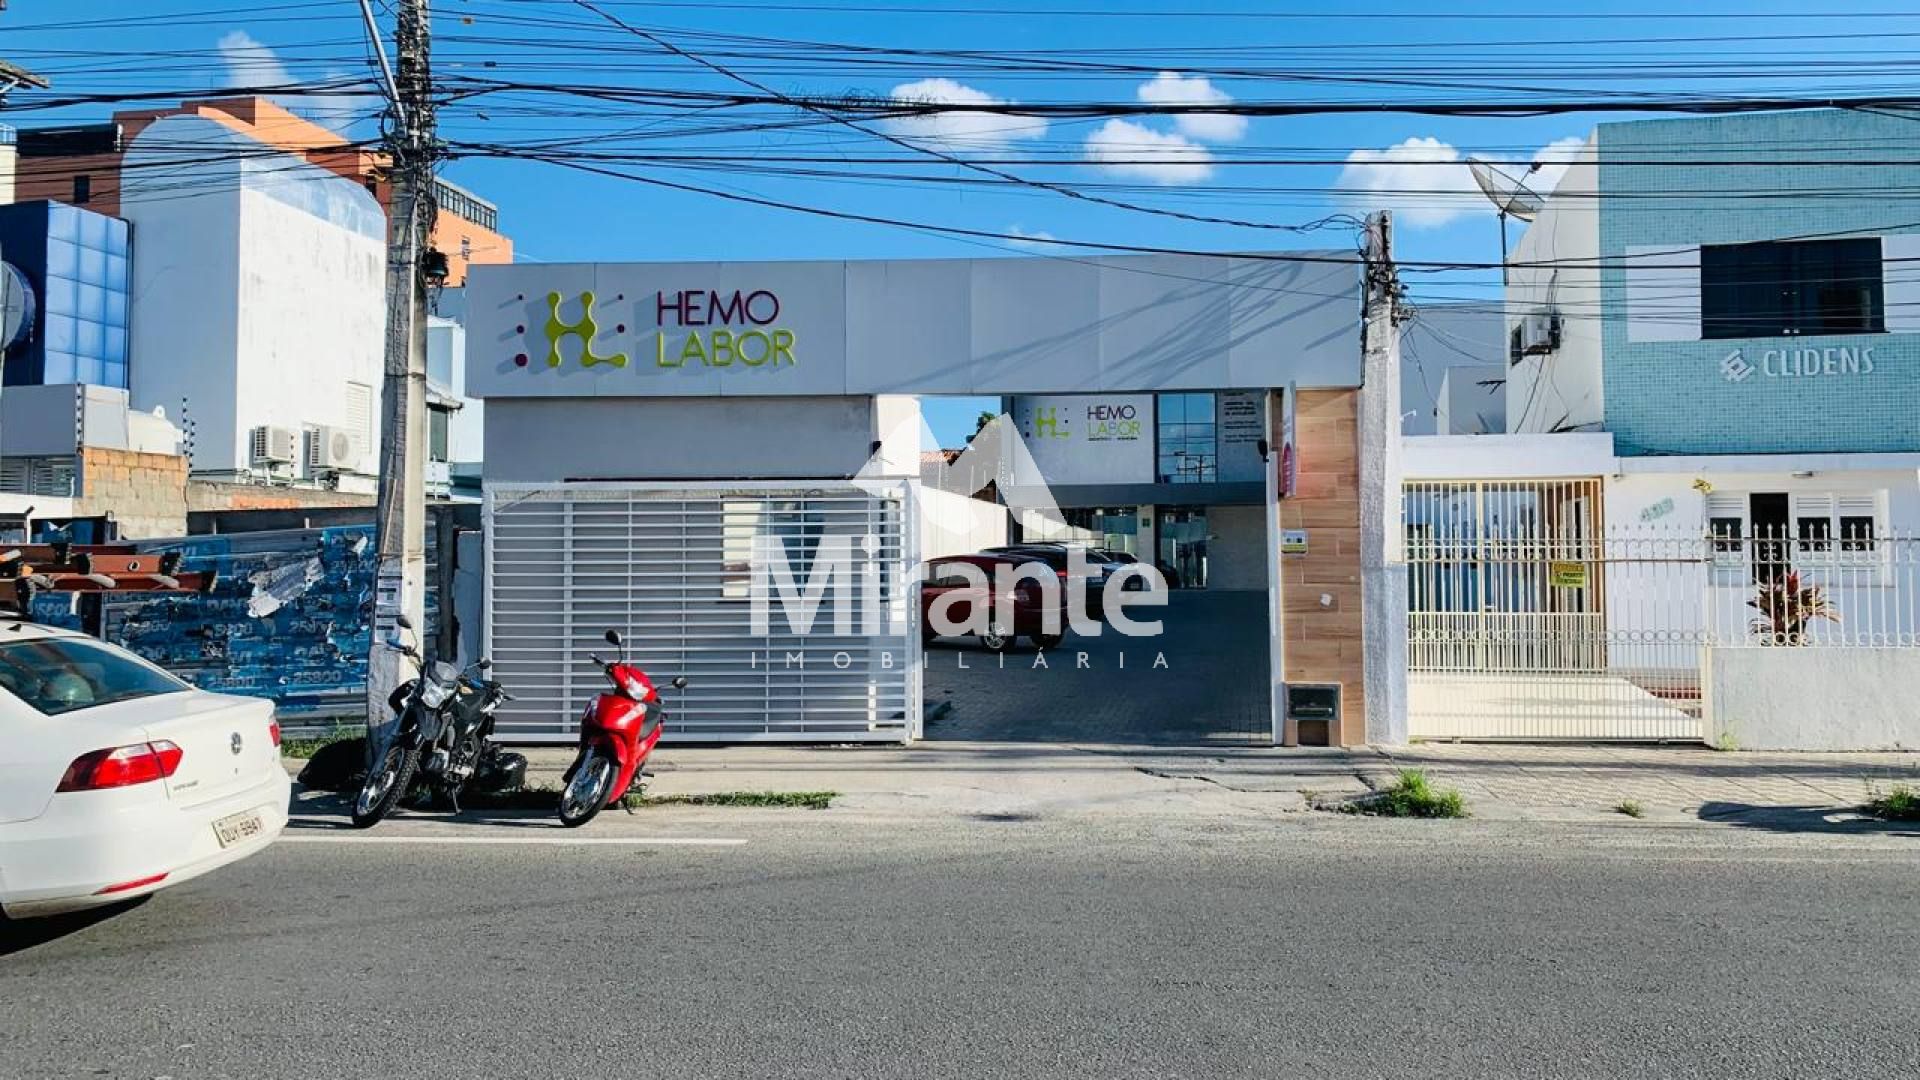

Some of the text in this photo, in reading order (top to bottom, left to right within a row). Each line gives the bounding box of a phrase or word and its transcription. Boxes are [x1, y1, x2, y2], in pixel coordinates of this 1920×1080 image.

[657, 290, 780, 326] HEMO
[656, 330, 796, 367] LABOR
[1763, 347, 1875, 377] CLIDENS
[1087, 404, 1136, 420] HEMO
[1088, 420, 1141, 436] LABOR
